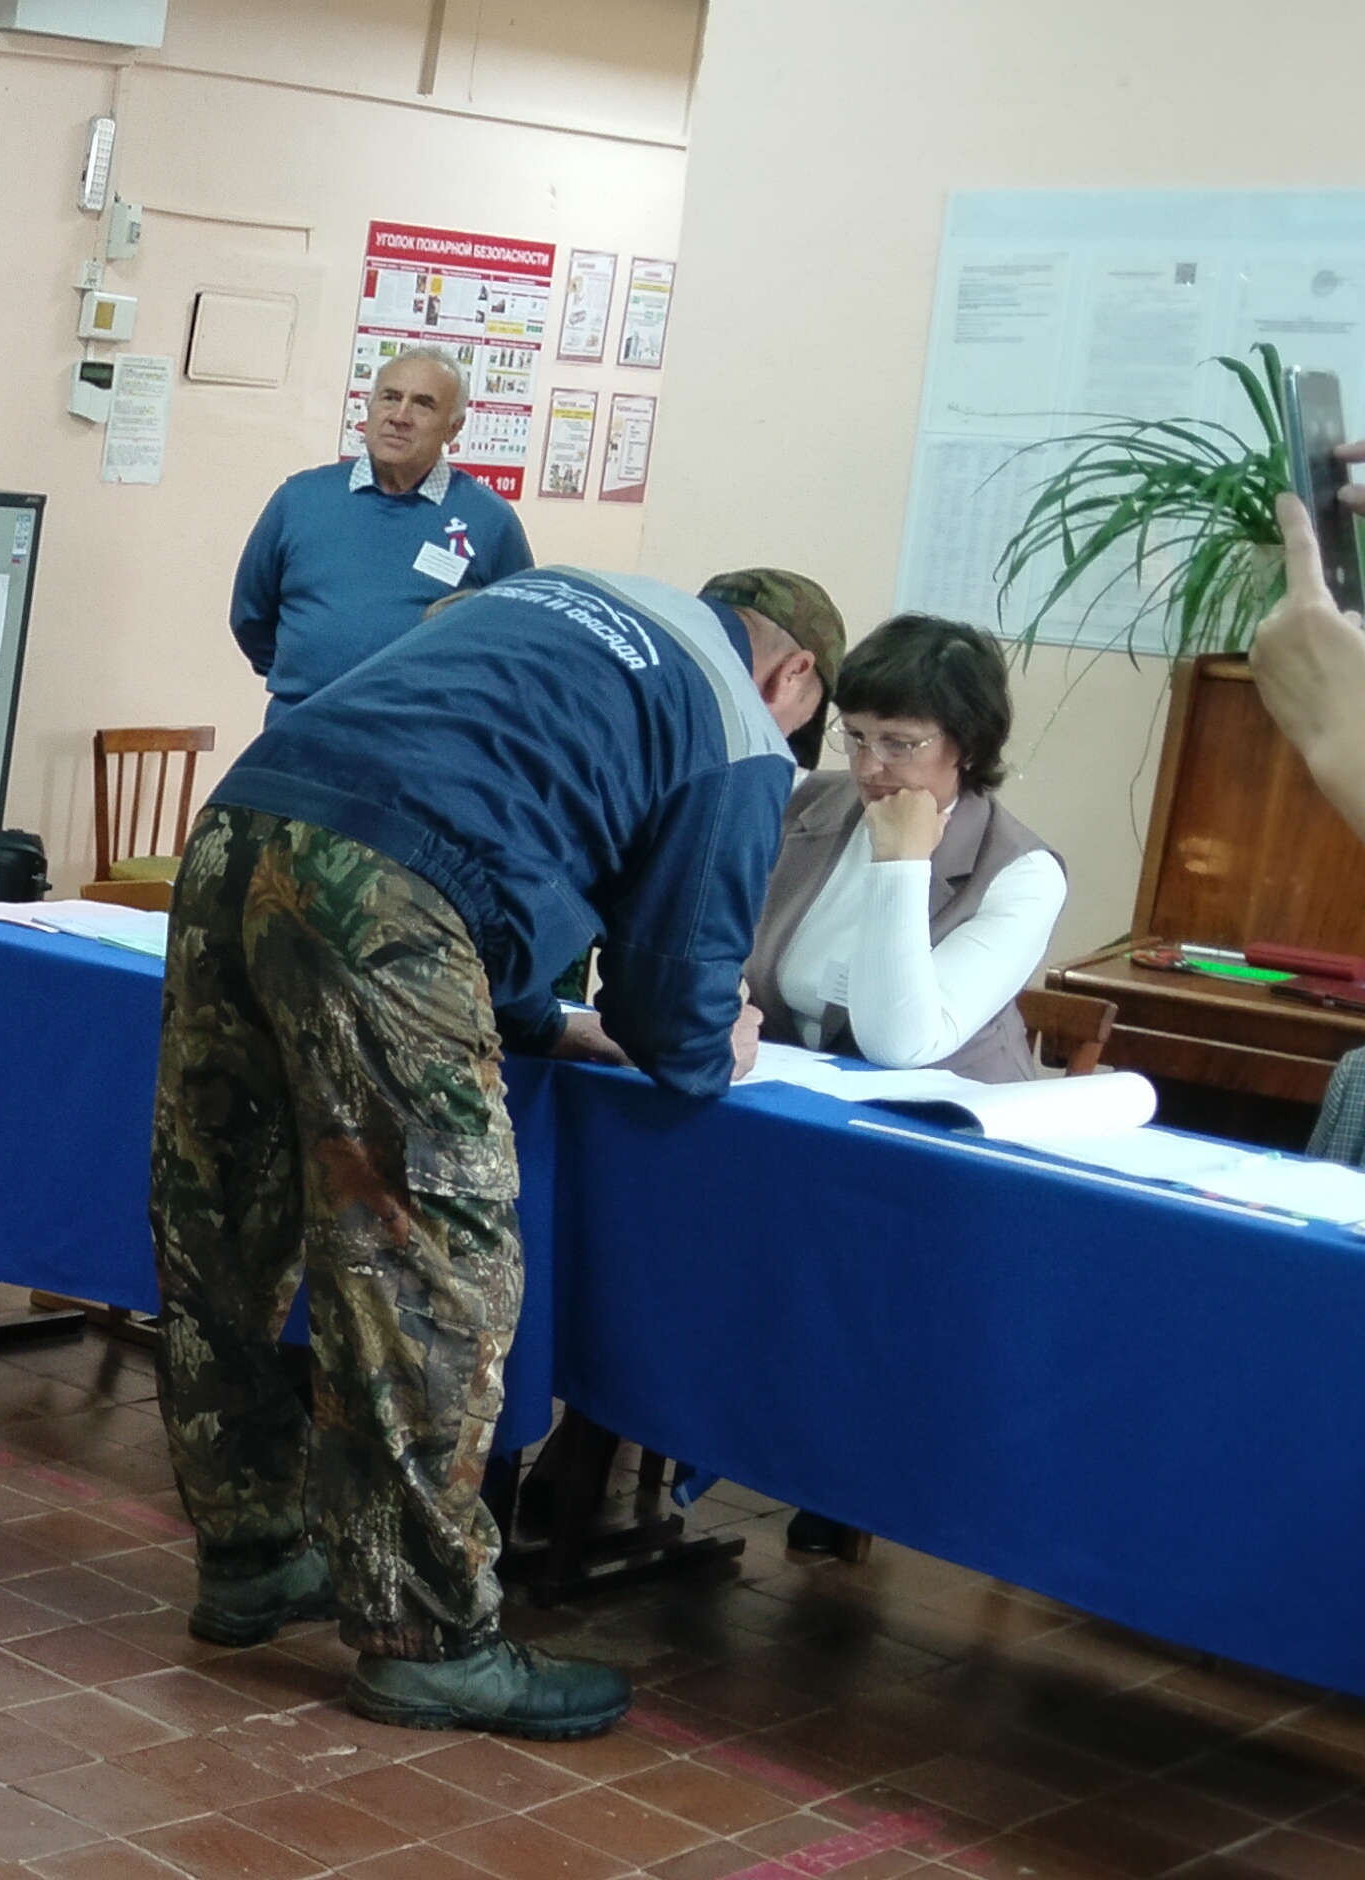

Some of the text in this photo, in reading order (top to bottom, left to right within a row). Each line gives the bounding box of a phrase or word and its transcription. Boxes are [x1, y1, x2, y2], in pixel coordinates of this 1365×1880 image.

[375, 231, 550, 267] УГОЛОК ПОЖАРНОЙ БЕЗОПАСНОСТИ
[496, 476, 517, 491] 101
[564, 607, 648, 670] ФАСАДА
